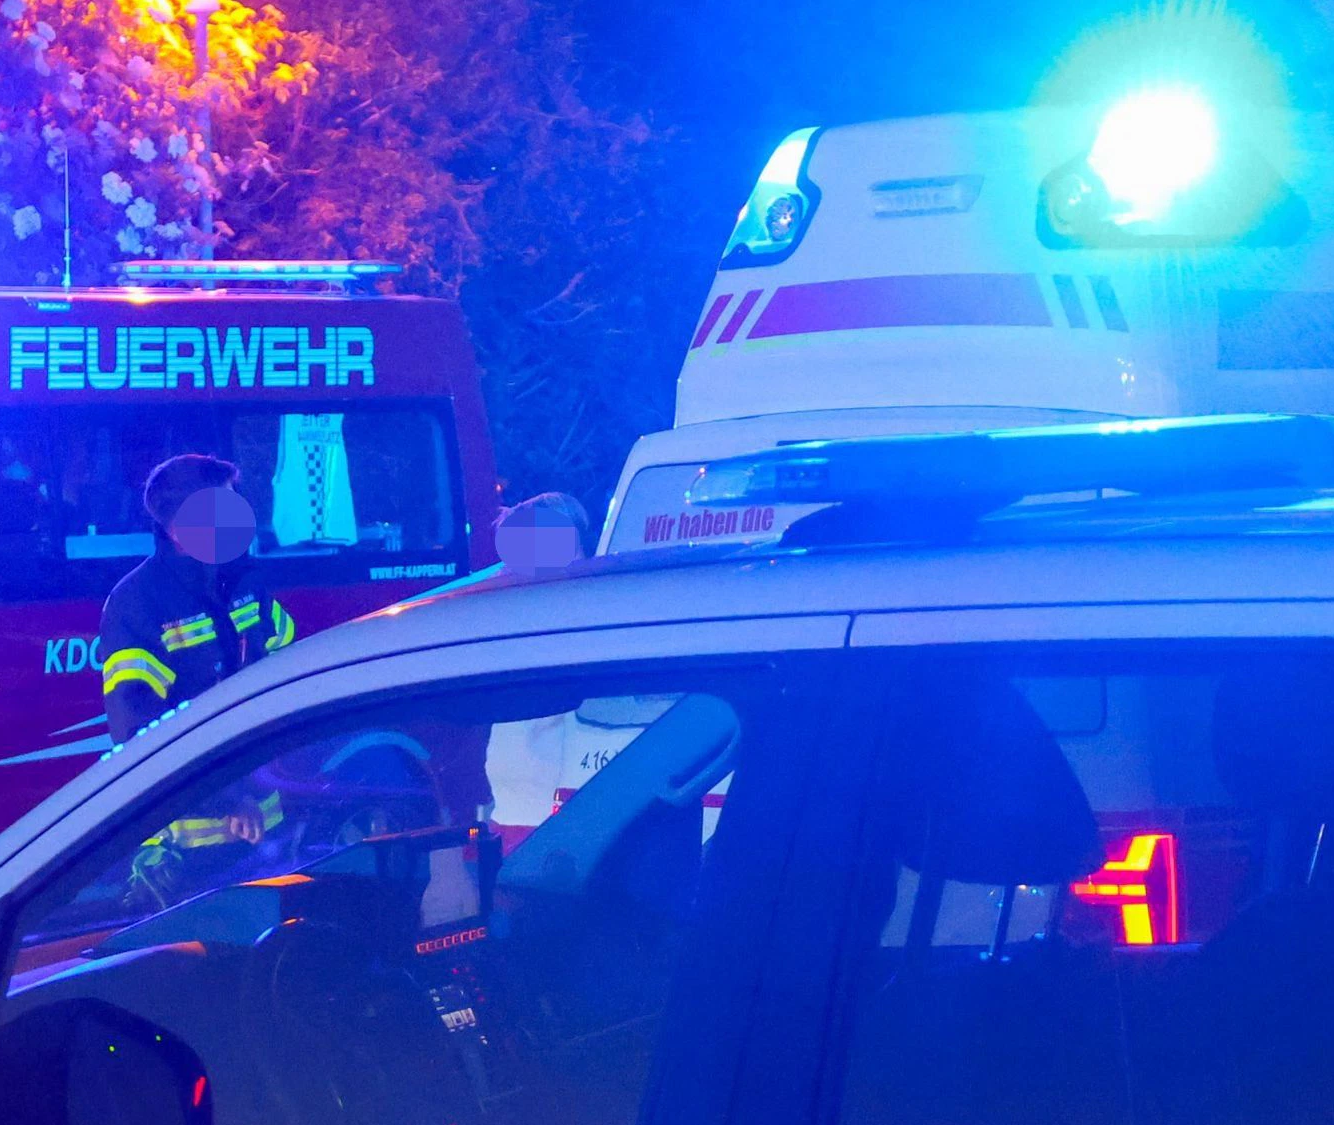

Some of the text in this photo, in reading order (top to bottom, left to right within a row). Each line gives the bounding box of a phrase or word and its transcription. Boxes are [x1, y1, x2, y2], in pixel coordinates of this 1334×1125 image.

[9, 326, 375, 390] FEUERWEHR
[644, 506, 774, 544] Wir haben die
[580, 749, 619, 771] 4.16
